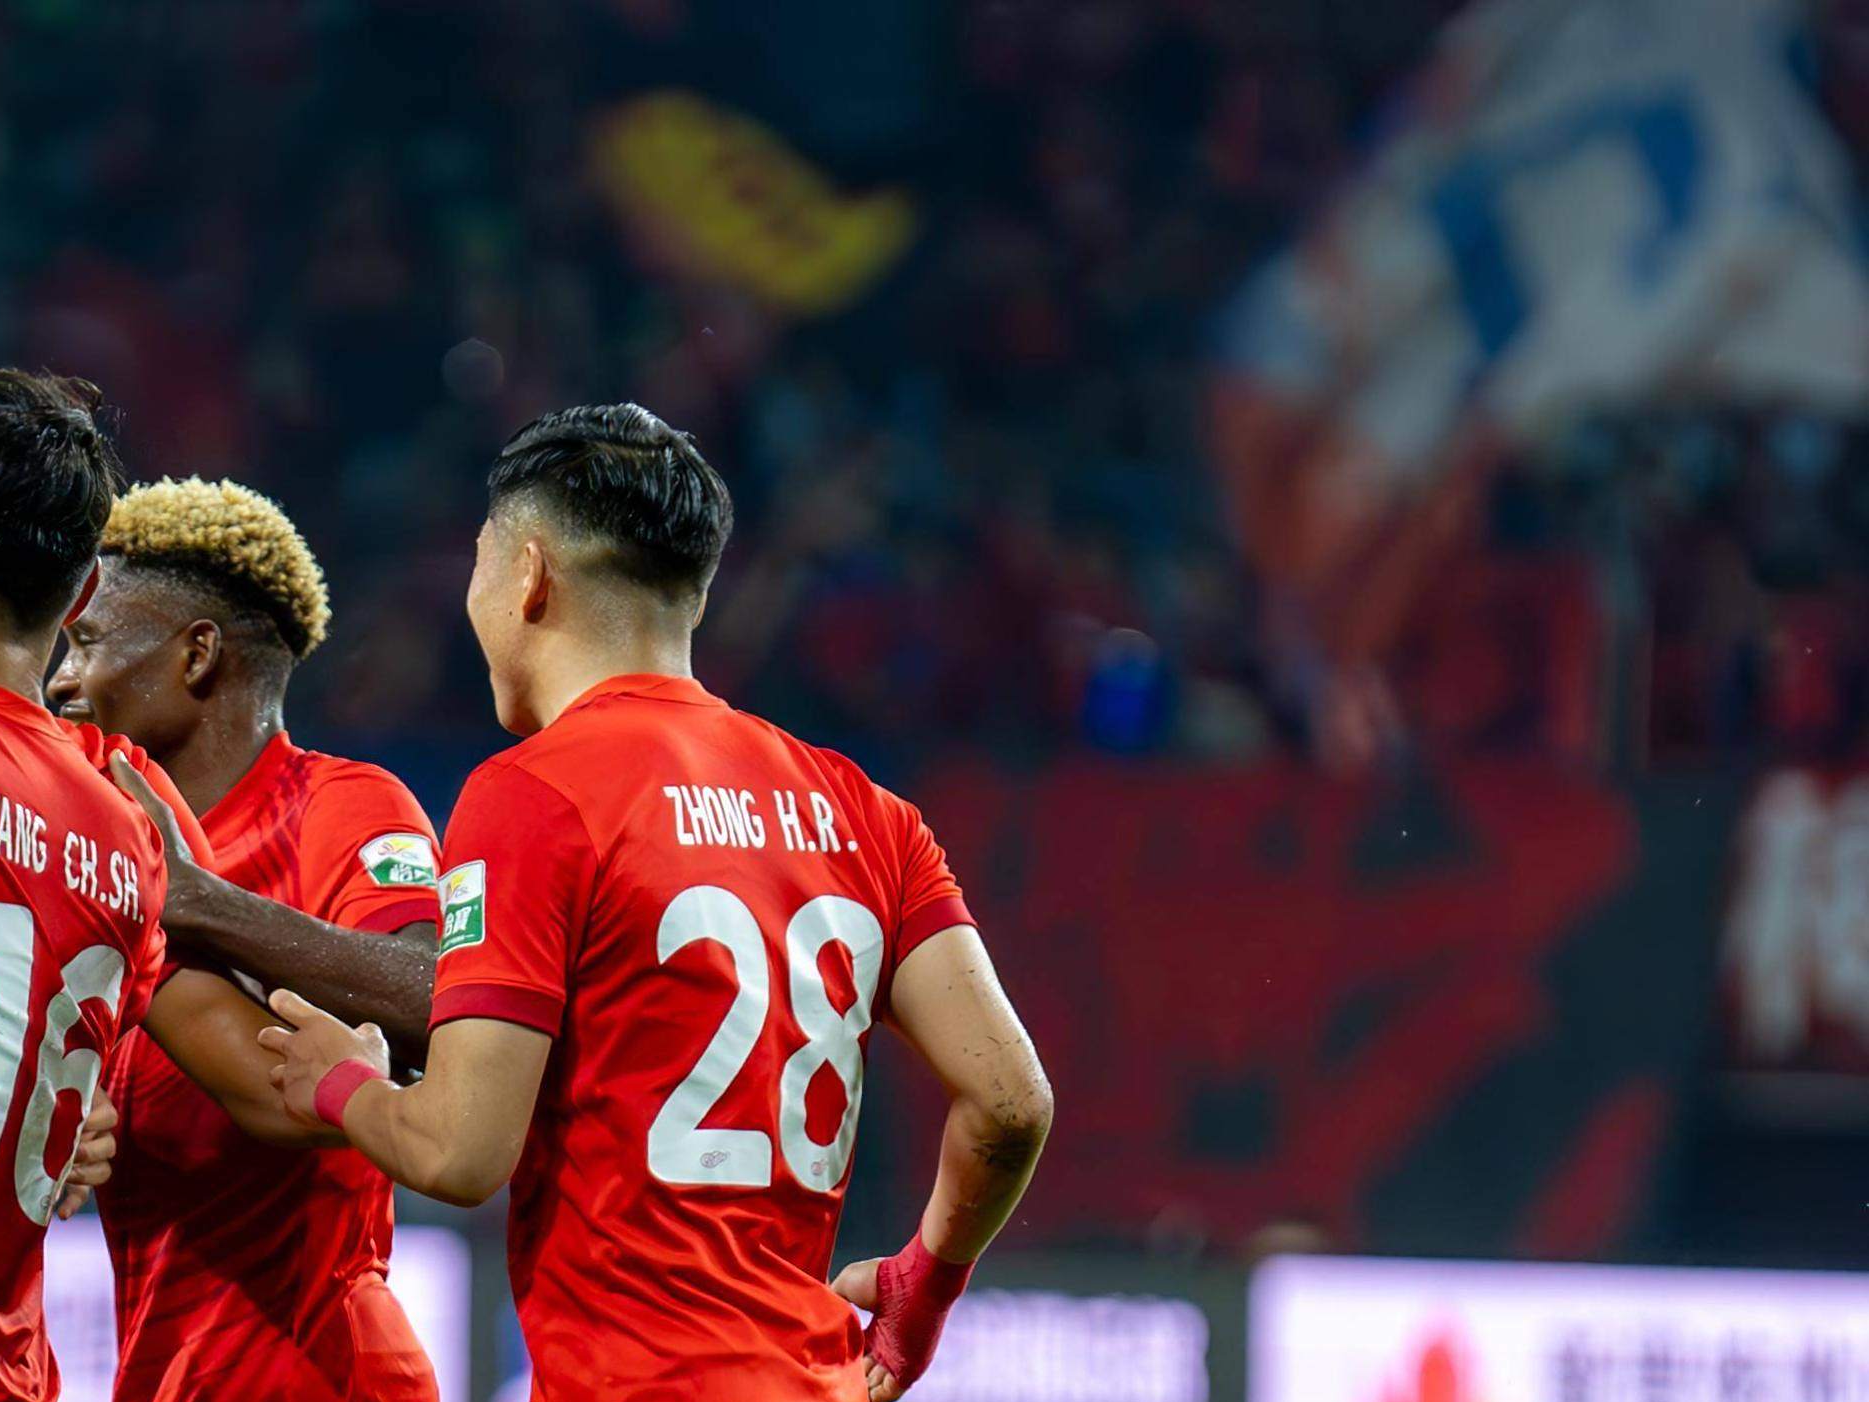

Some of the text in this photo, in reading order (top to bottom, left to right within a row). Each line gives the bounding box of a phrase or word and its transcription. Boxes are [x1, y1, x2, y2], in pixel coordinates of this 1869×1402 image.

[663, 785, 859, 853] ZHONG H.R.
[63, 830, 144, 924] CH.SH.
[647, 885, 884, 1193] 28
